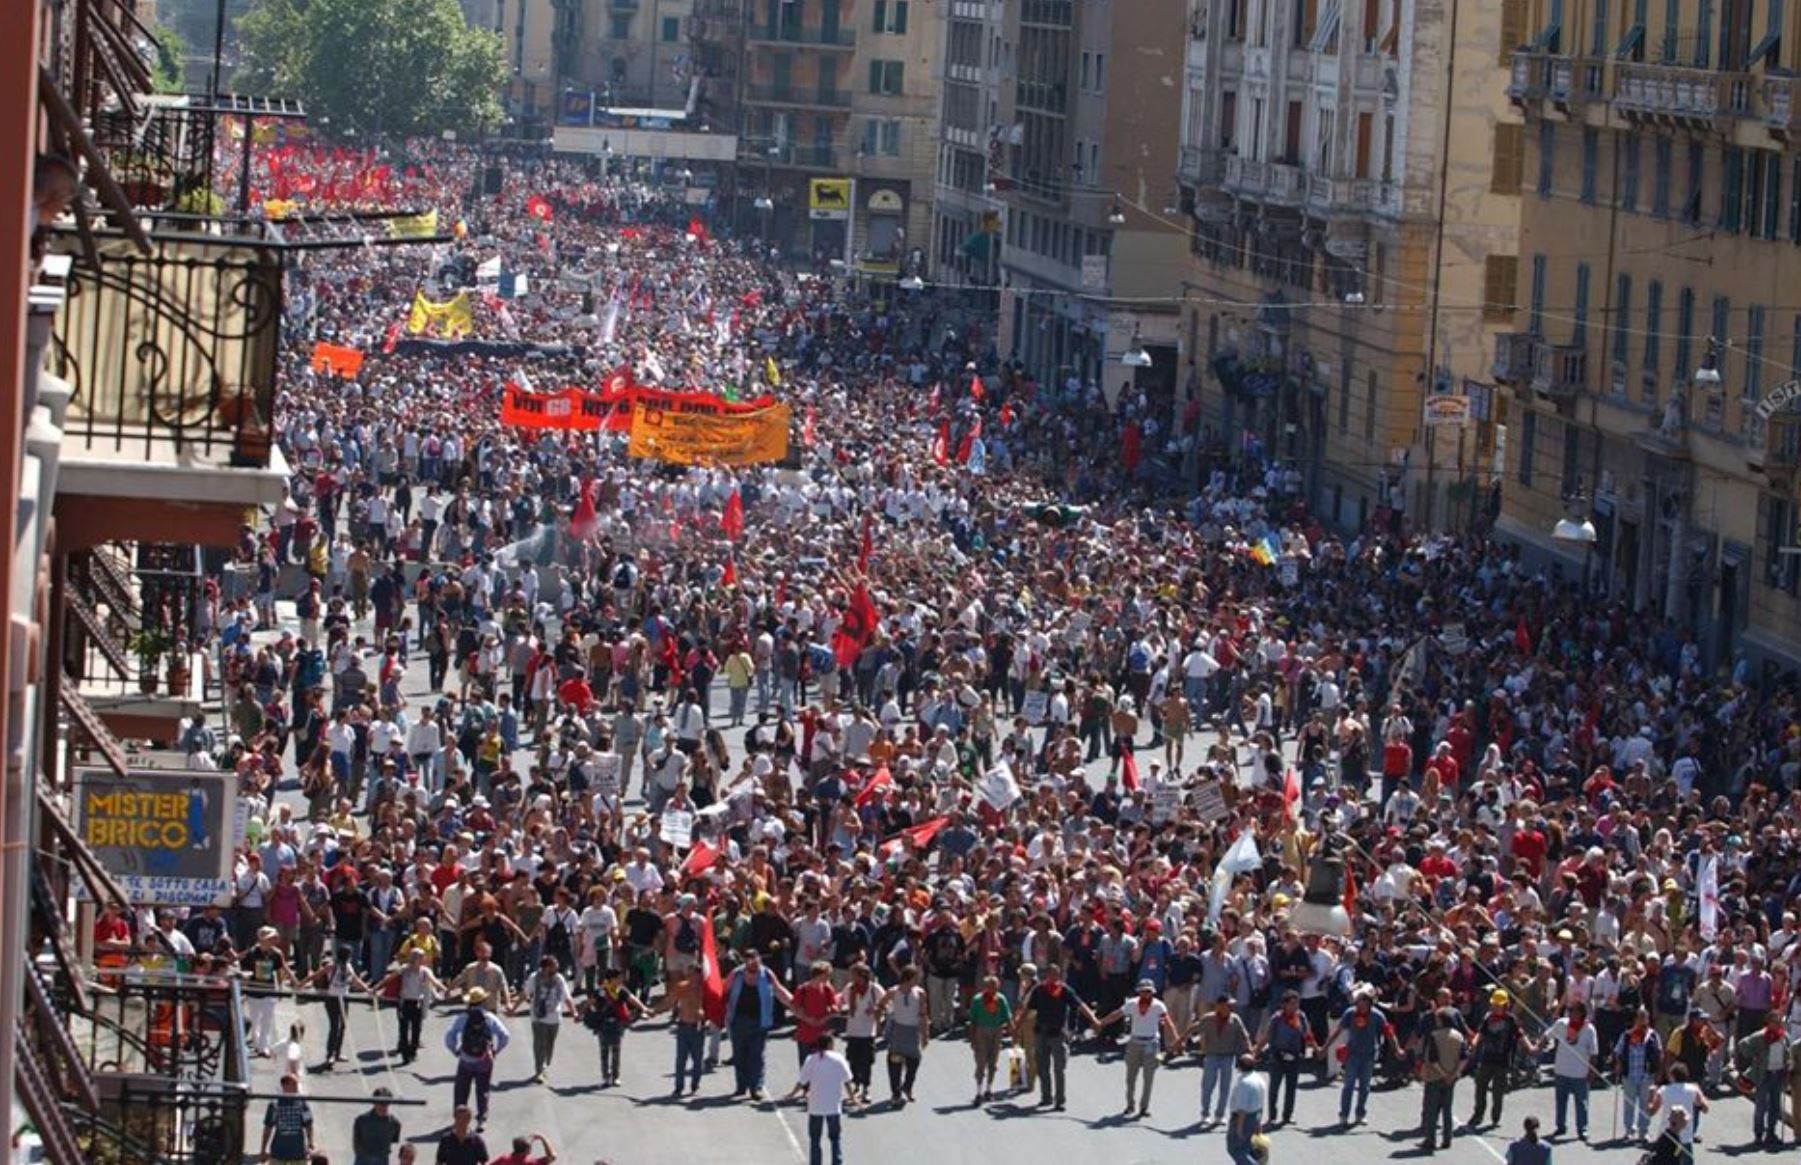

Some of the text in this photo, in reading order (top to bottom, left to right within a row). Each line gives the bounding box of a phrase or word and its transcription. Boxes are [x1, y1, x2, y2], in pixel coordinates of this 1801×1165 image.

[87, 792, 190, 819] MISTER
[87, 818, 188, 849] BRICO
[150, 877, 189, 890] SOTTO
[194, 879, 227, 891] CASA
[155, 890, 218, 903] DISCOUNT
